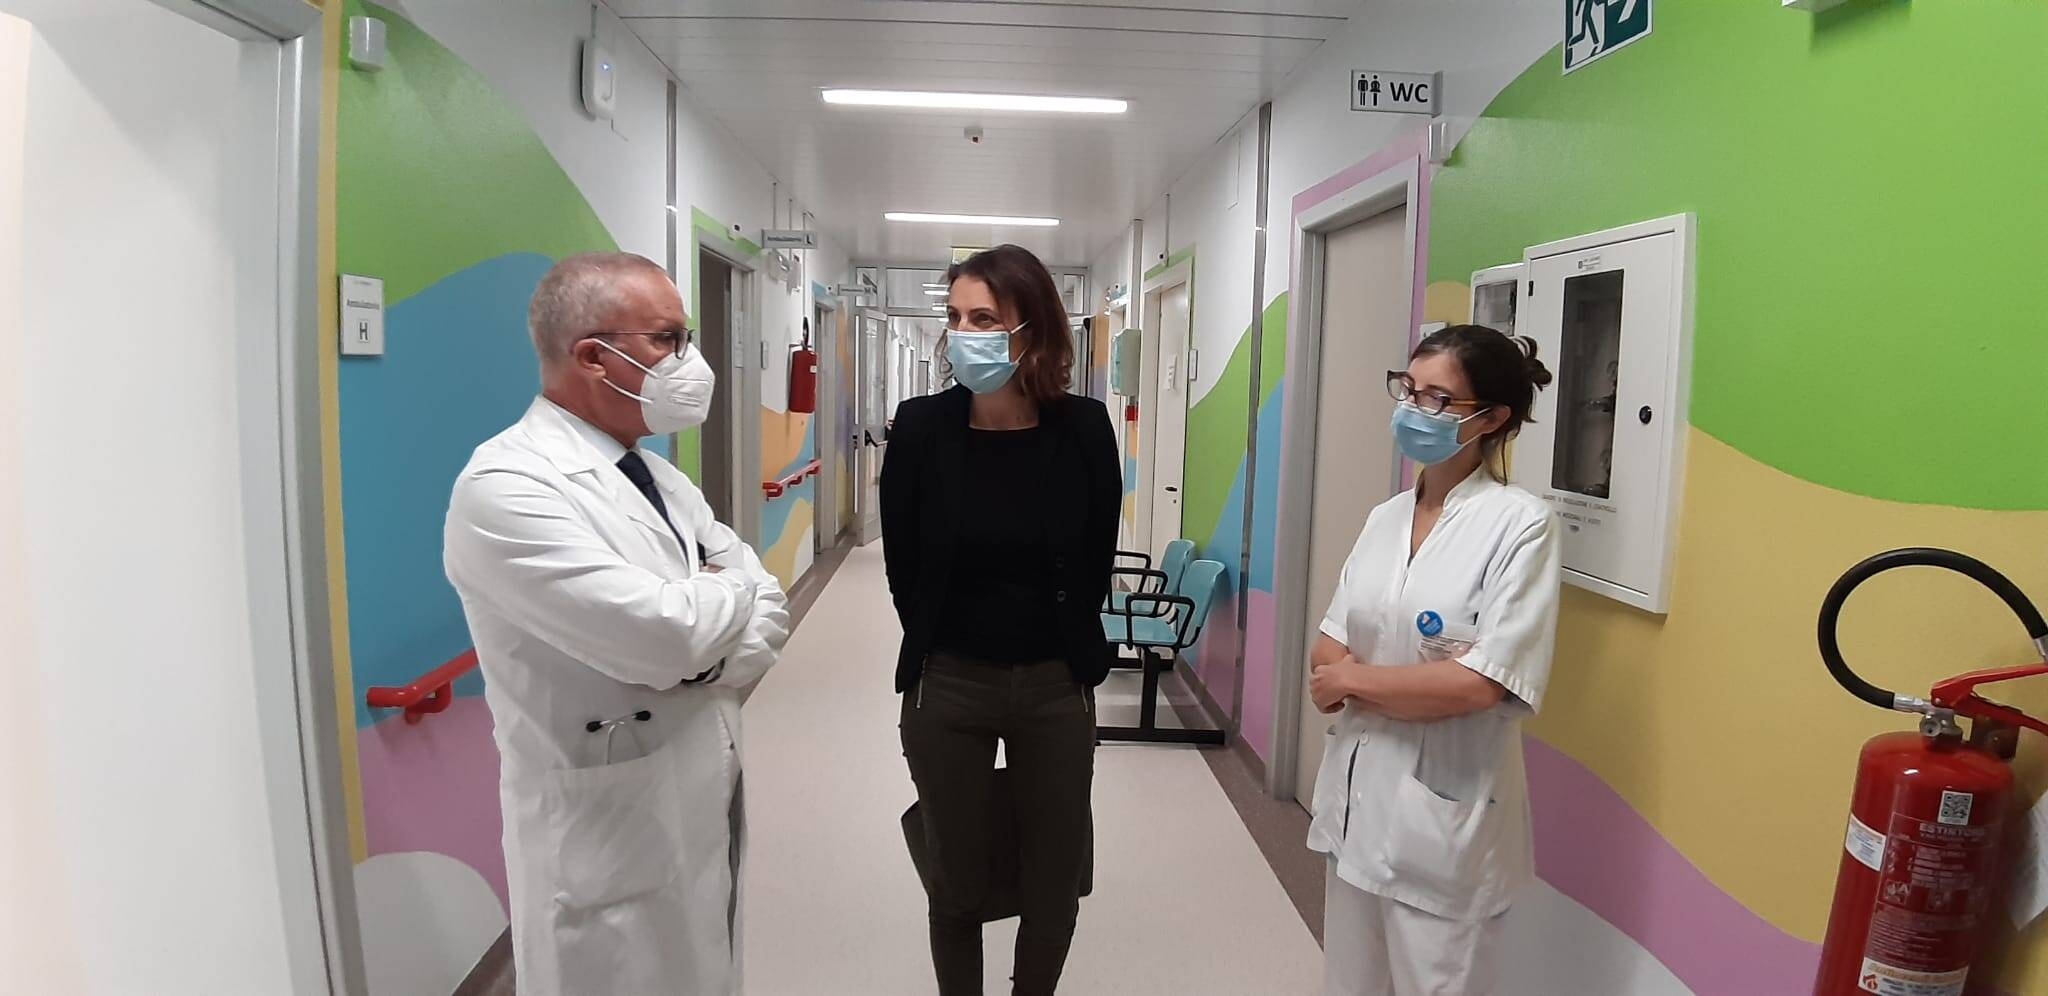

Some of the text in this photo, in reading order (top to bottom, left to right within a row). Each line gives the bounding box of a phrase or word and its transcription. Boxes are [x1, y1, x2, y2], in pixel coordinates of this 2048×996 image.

[1389, 81, 1429, 103] WC
[806, 234, 813, 244] L
[359, 321, 368, 341] H
